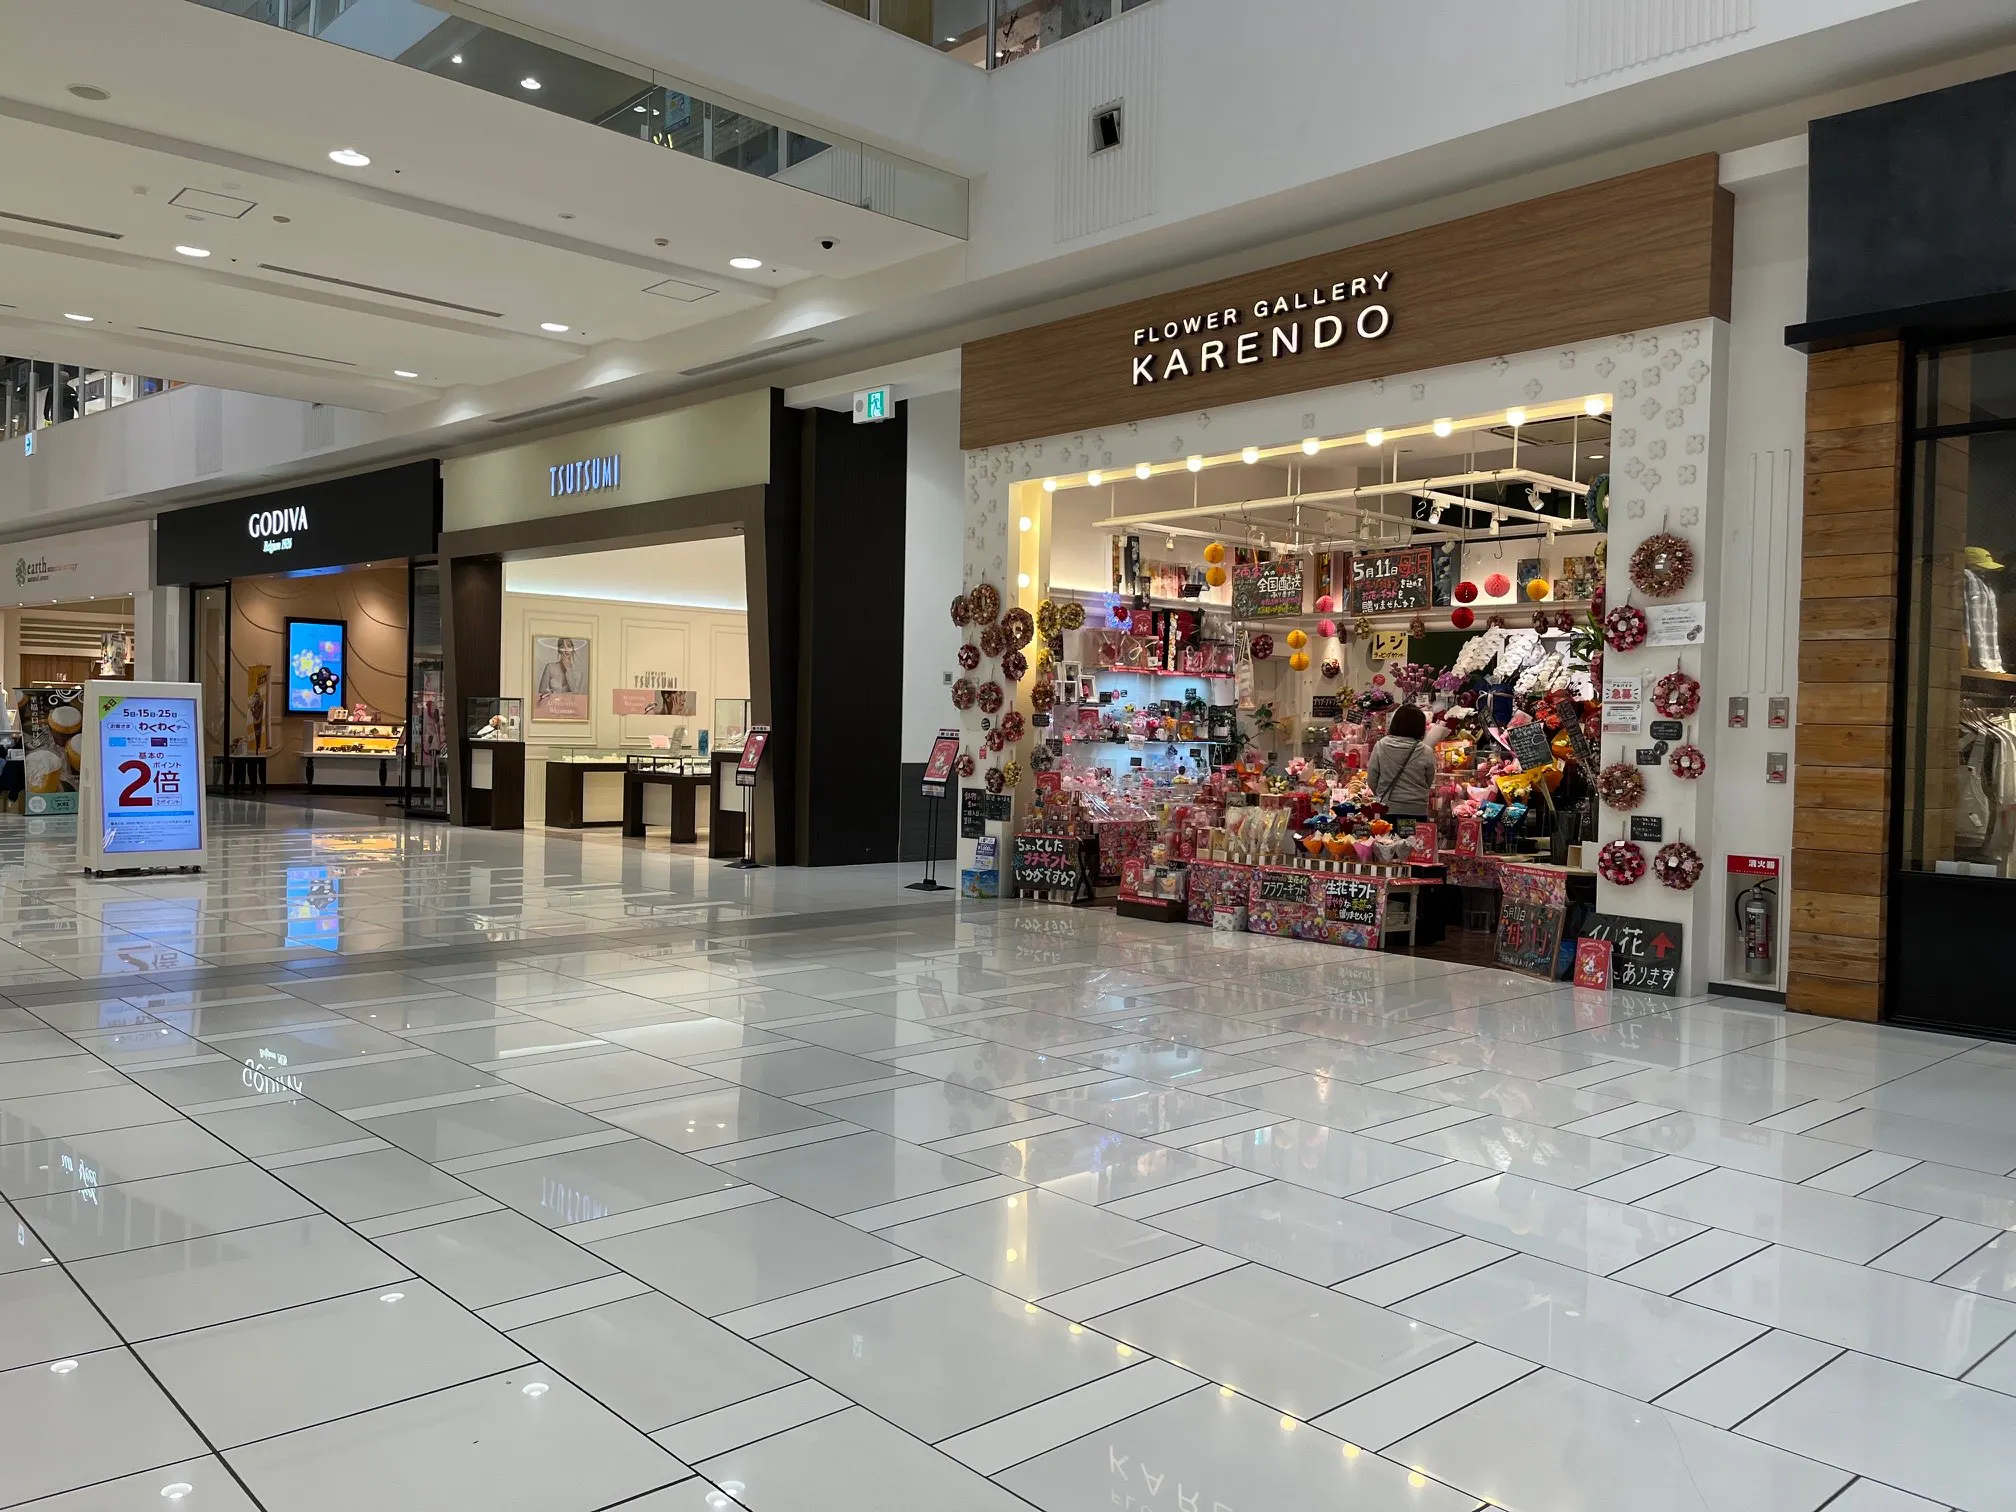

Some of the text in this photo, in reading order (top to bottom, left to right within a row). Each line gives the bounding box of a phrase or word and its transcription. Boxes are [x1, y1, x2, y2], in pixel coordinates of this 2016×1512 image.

[1134, 270, 1390, 345] FLOWER GALLERY
[1132, 304, 1391, 385] KARENDO
[549, 454, 621, 497] TSUTSUMI
[248, 505, 309, 538] GODIVA
[27, 556, 47, 574] earth
[1257, 574, 1302, 593] 全国配送
[1376, 632, 1406, 650] レジ
[634, 675, 678, 689] TSUTSUMI
[1611, 688, 1632, 700] 急募
[1015, 838, 1063, 852] ちょっとした
[1024, 852, 1072, 870] プチギフト
[1748, 859, 1775, 869] 消火器
[1015, 868, 1076, 887] いかがですか?
[1263, 881, 1306, 898] フラワーギフト
[1326, 881, 1376, 899] 生花ギフト
